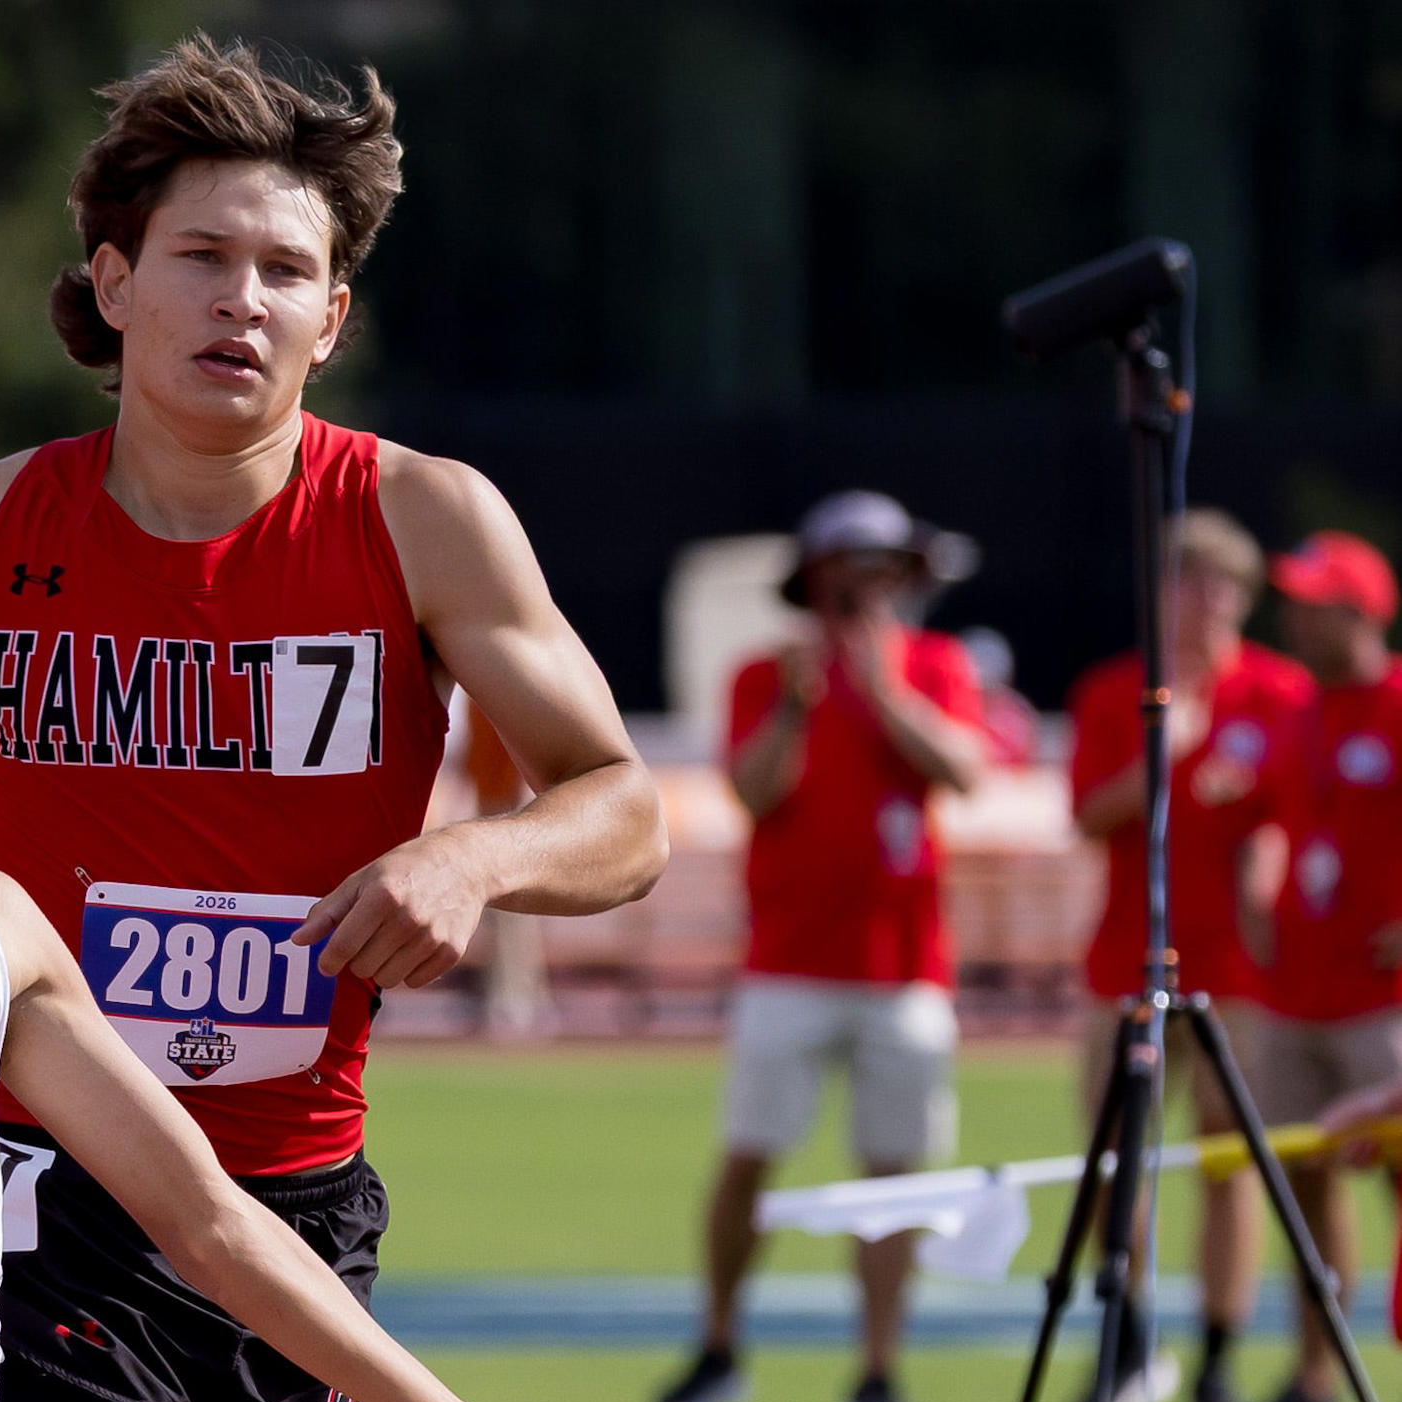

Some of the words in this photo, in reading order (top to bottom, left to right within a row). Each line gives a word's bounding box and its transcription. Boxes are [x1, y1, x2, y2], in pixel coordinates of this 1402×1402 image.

[296, 644, 355, 768] 7
[195, 895, 236, 910] 2026
[105, 917, 312, 1015] 2801
[168, 1042, 234, 1060] STATE
